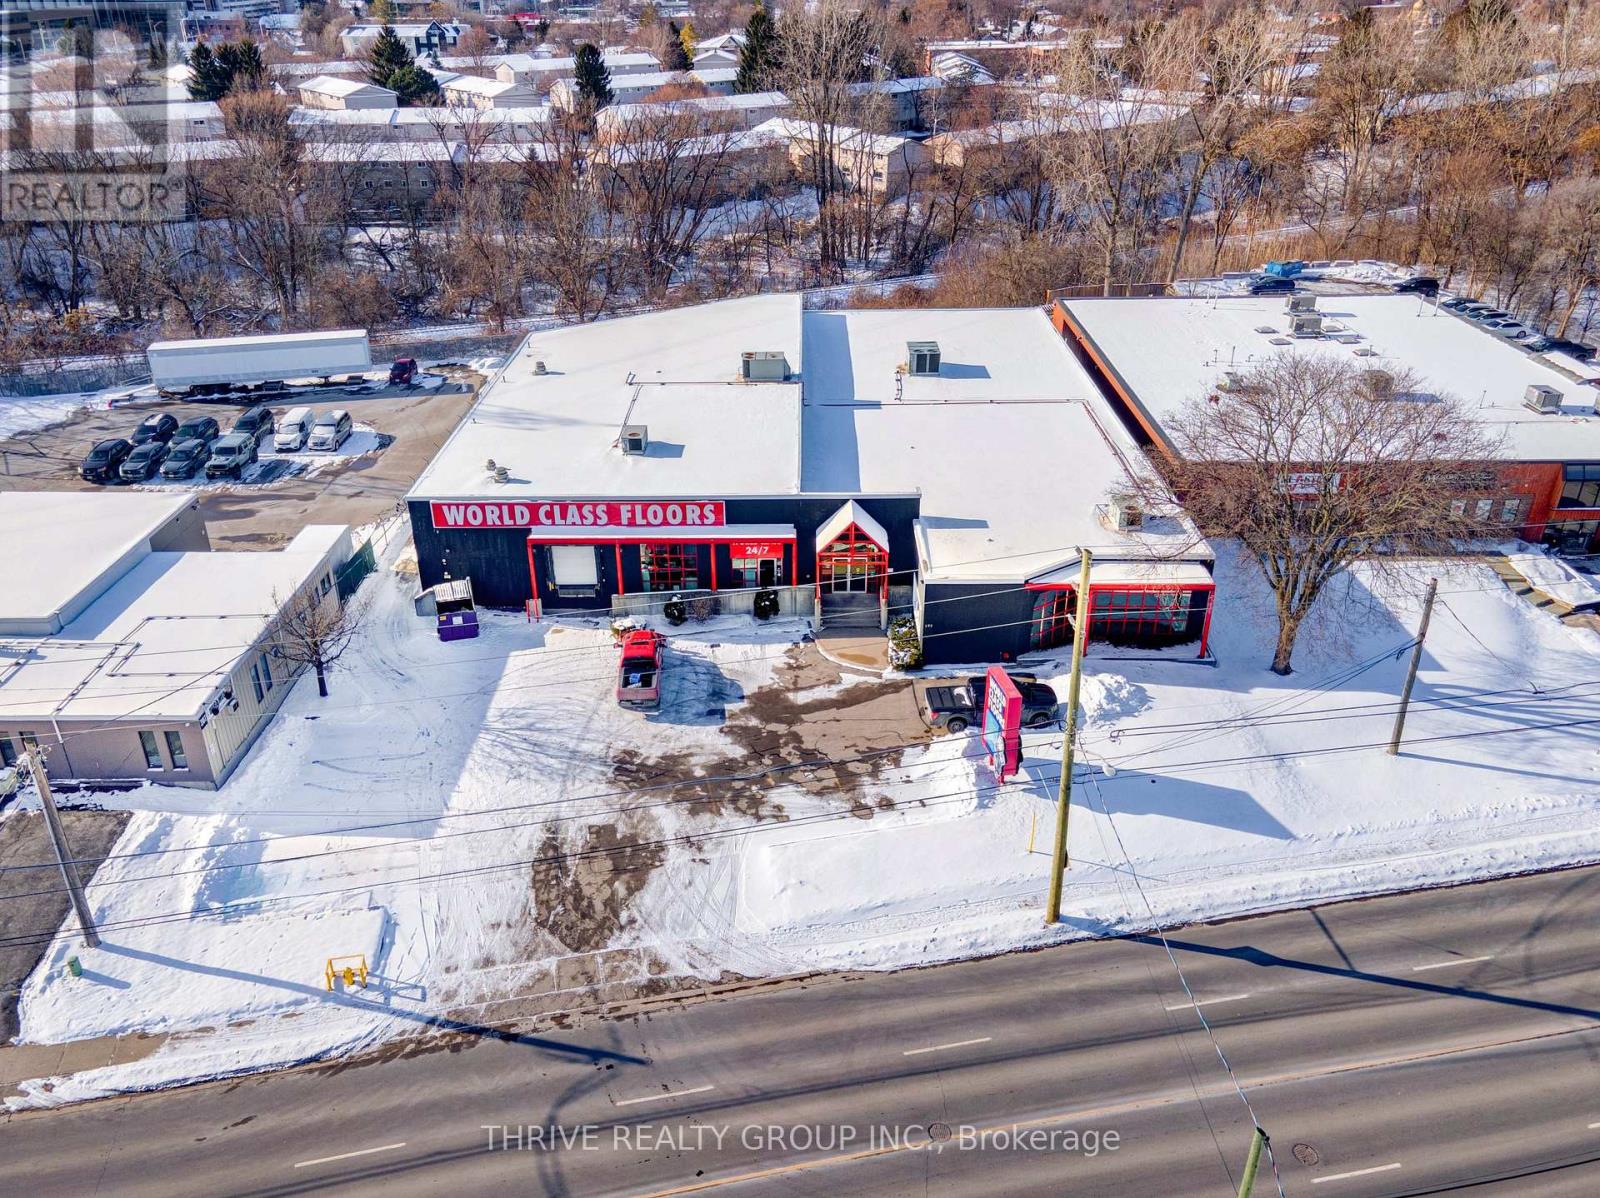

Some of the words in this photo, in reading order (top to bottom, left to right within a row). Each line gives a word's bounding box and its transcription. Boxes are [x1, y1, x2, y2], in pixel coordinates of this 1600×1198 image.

[442, 504, 531, 526] WORLD
[538, 504, 609, 526] CLASS
[619, 504, 716, 526] FLOORS
[745, 546, 769, 555] 24/7
